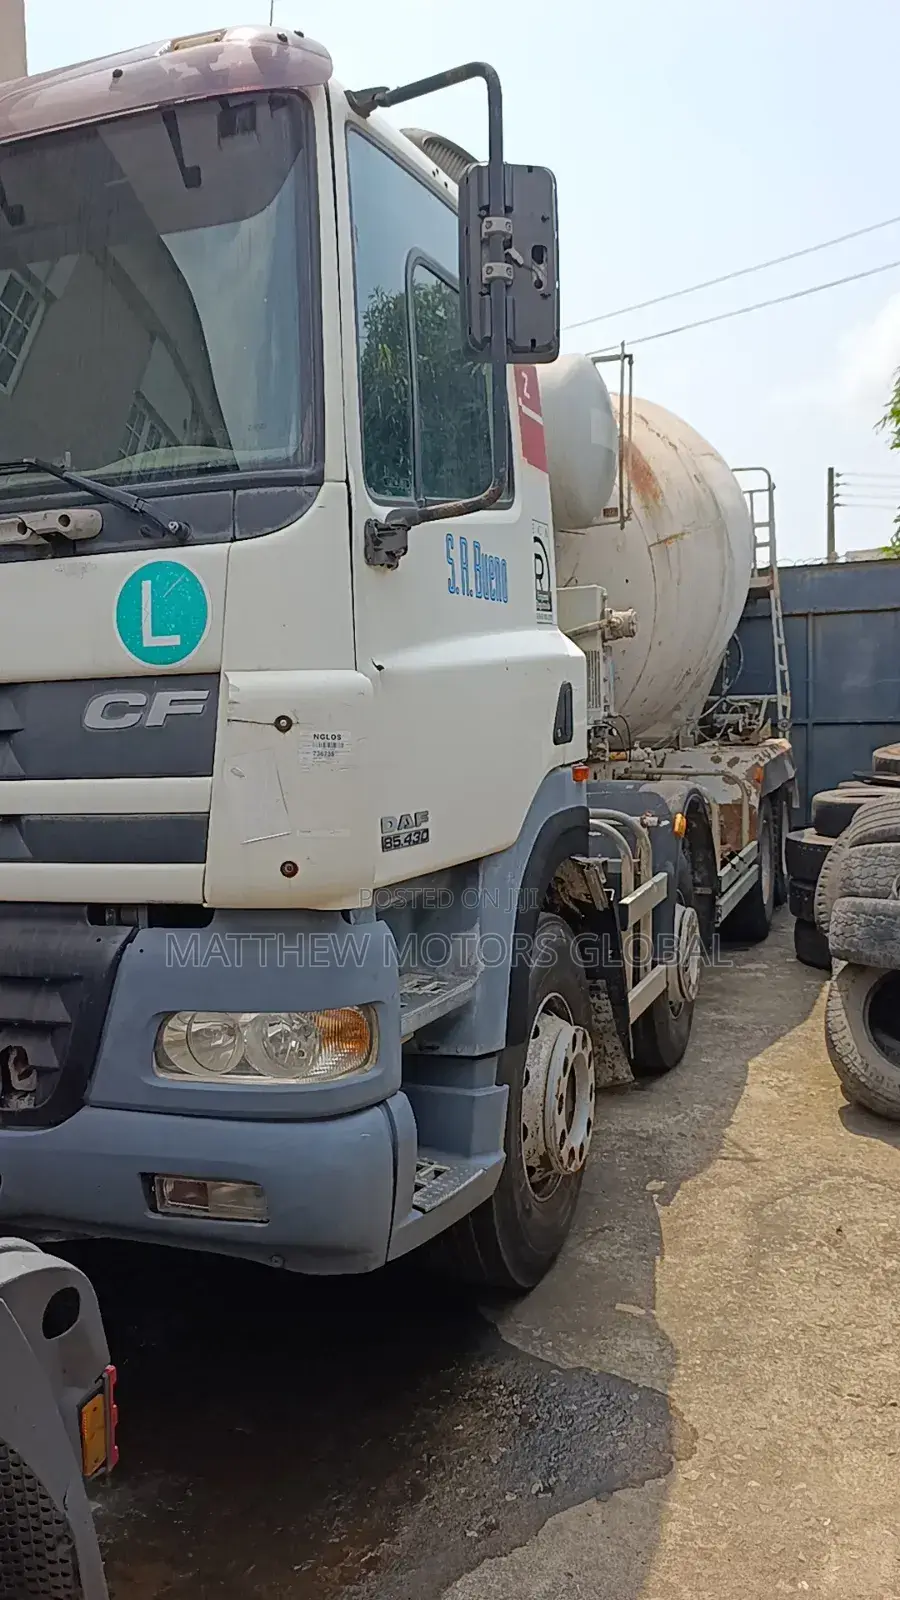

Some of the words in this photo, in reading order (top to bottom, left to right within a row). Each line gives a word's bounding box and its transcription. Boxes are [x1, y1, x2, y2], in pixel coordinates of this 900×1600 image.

[141, 579, 181, 647] L
[83, 690, 210, 730] CF
[313, 733, 342, 741] NGLOS
[380, 810, 429, 834] DAF
[383, 829, 430, 851] 85.430
